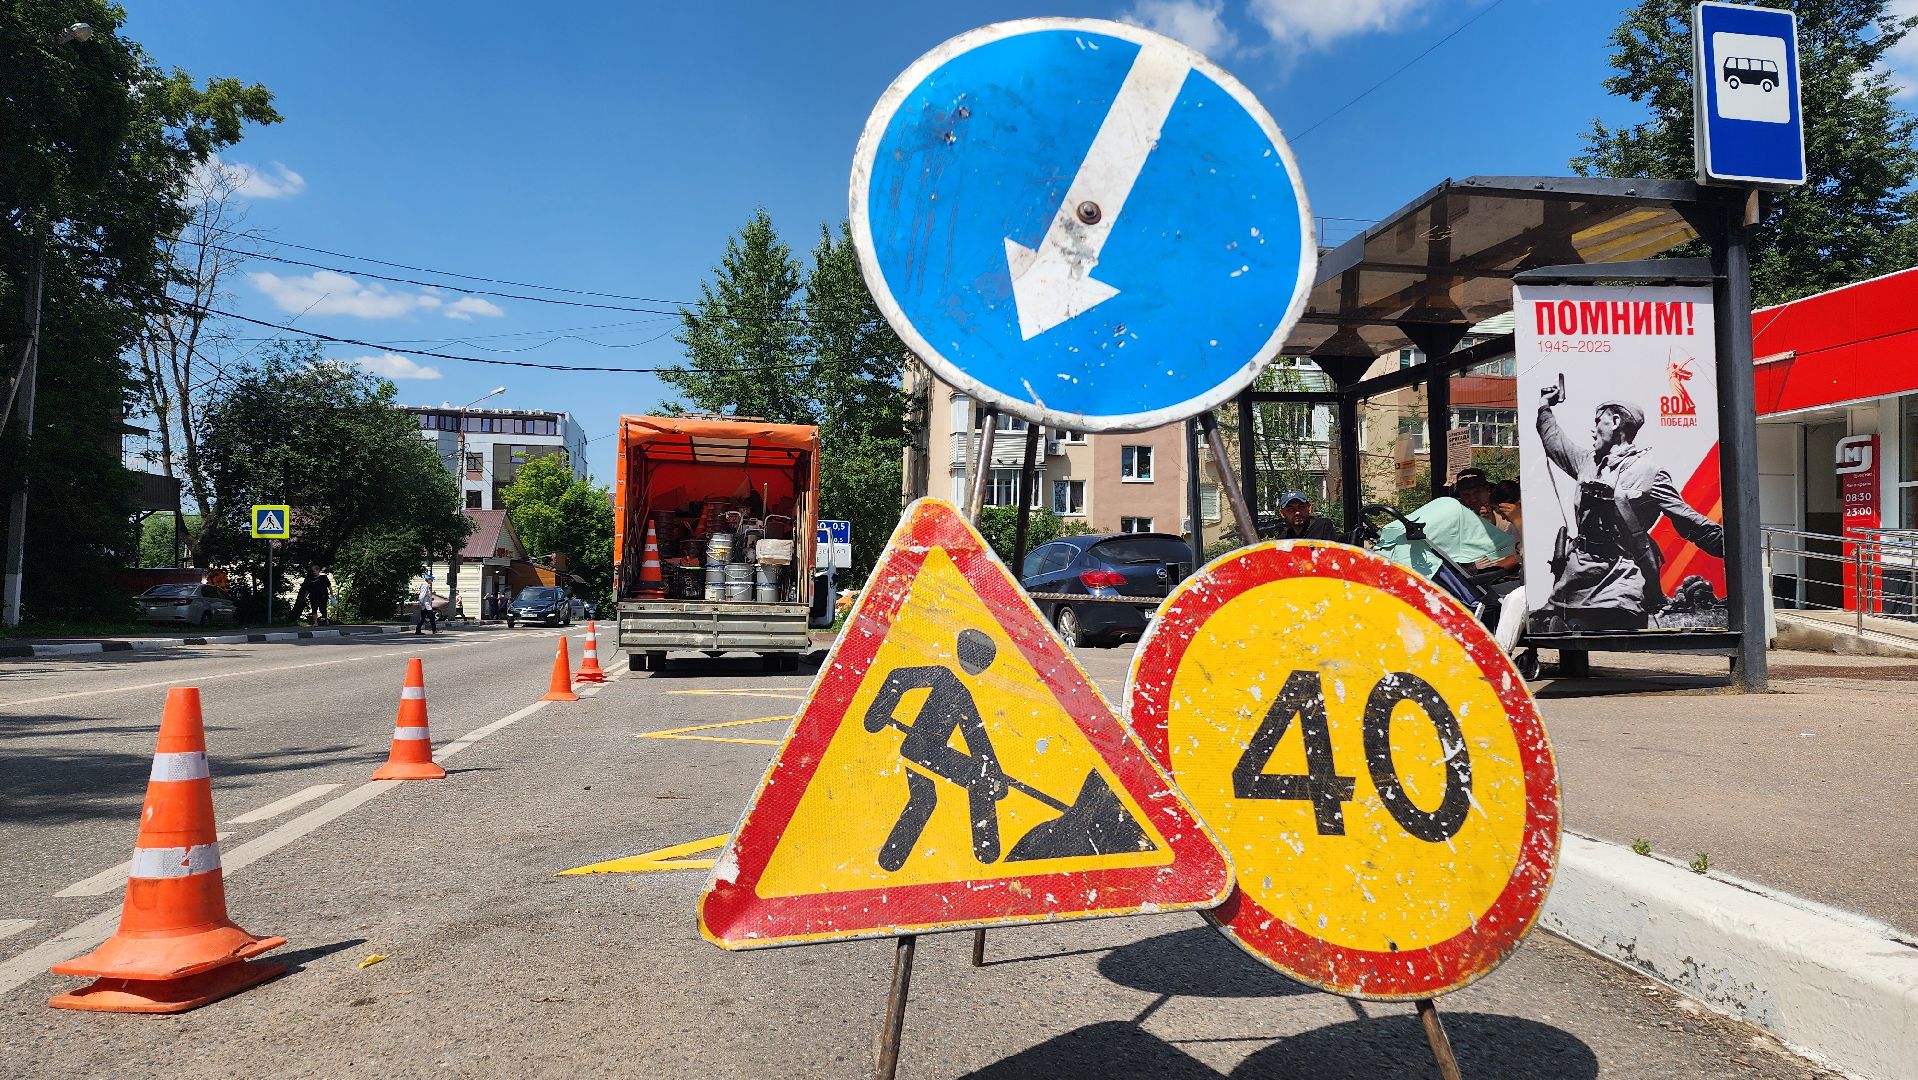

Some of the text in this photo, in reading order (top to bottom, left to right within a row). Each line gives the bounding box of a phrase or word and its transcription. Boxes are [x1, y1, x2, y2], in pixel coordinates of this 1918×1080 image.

[1535, 300, 1695, 336] ПОМНИМ!
[1660, 396, 1680, 414] 80
[1660, 417, 1697, 428] ПОБЕДА!
[1845, 492, 1872, 502] 08:30
[1846, 506, 1872, 517] 23:00
[833, 522, 845, 531] 0,5
[1232, 669, 1473, 843] 40
